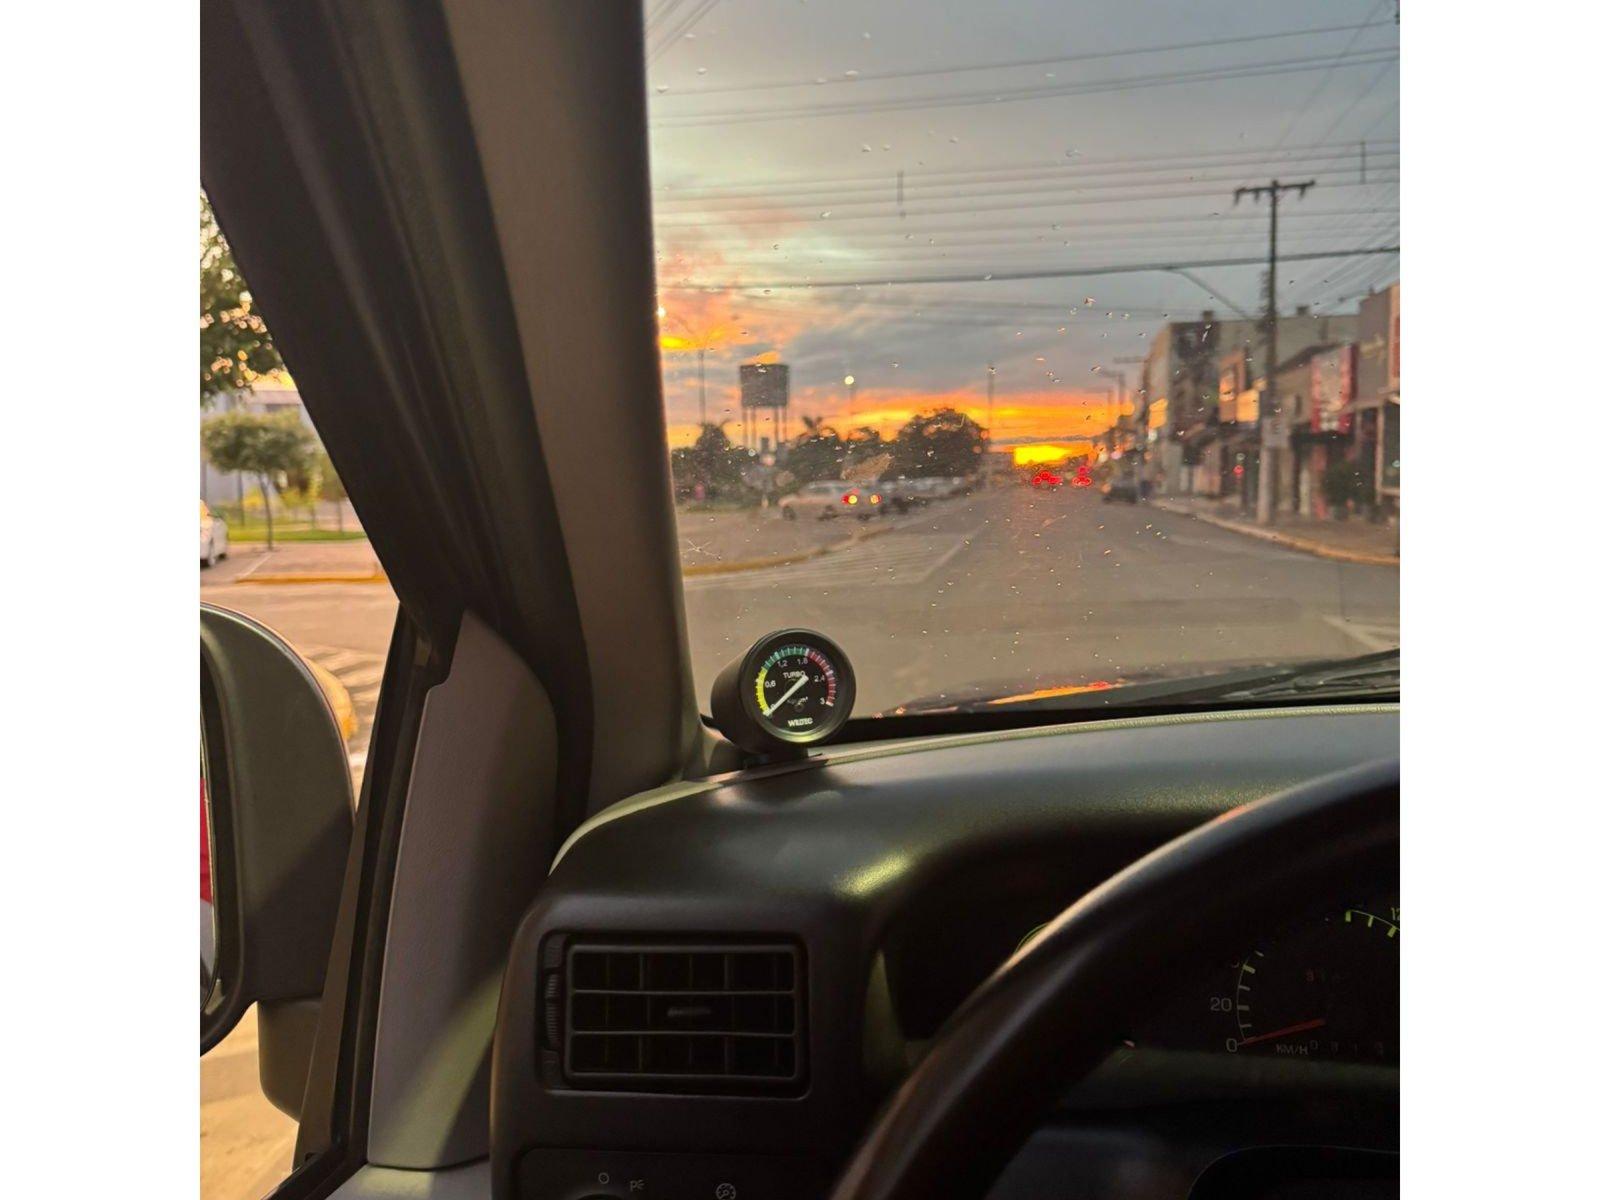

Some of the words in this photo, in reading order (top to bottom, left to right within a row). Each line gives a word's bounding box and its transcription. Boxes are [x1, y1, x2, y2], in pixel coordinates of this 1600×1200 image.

[783, 671, 806, 679] TURBO
[1210, 997, 1232, 1011] 20
[1226, 1038, 1238, 1052] 0
[1275, 1043, 1309, 1055] KM/H
